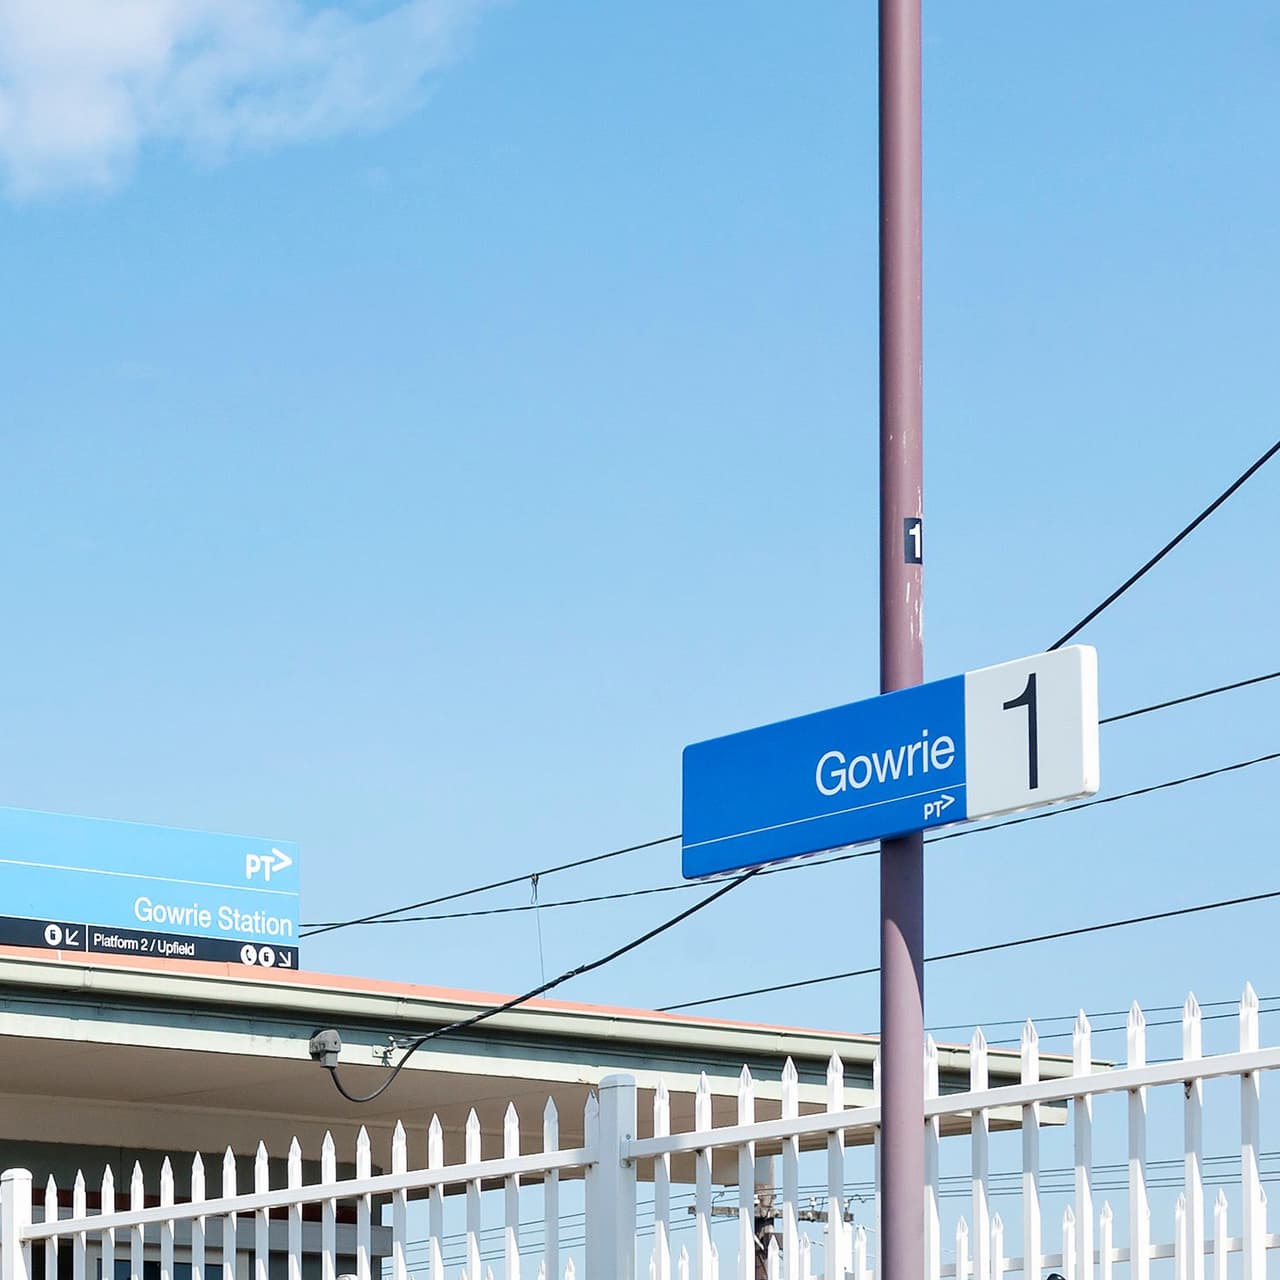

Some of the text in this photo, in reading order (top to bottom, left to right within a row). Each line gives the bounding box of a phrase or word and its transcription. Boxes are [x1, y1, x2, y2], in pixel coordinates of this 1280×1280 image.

[909, 522, 922, 559] 1
[1002, 672, 1040, 790] 1
[815, 729, 956, 797] Gowrie
[134, 897, 293, 937] Gowrie Station
[93, 932, 139, 951] Platform
[141, 938, 149, 951] 2
[157, 939, 195, 957] Upfield
